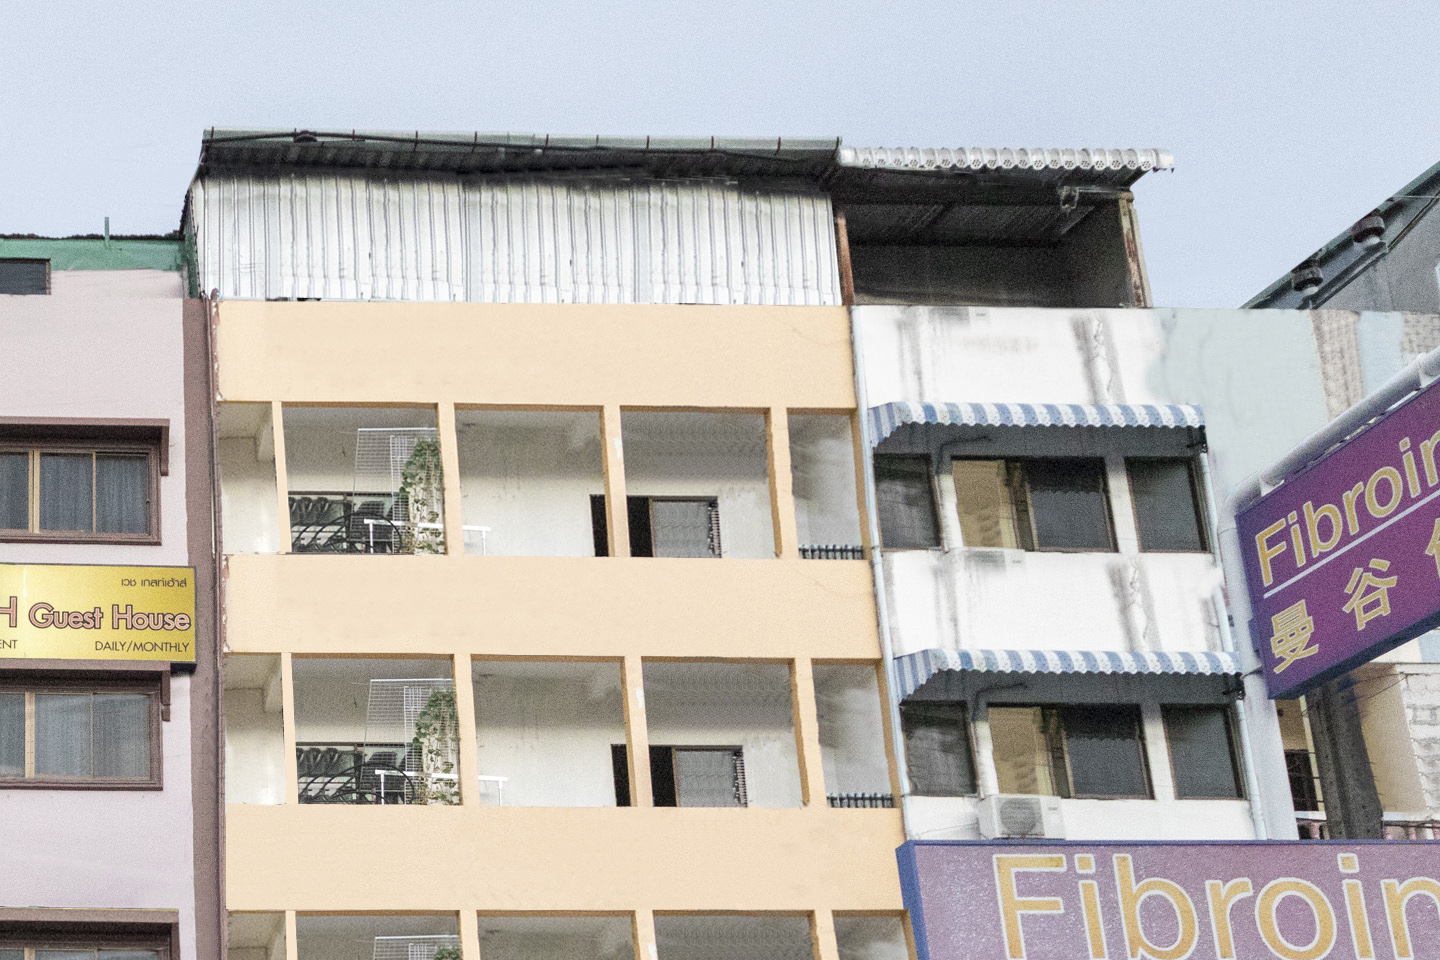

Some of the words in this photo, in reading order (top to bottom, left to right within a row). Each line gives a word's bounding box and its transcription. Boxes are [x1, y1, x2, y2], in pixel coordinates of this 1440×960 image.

[1270, 519, 1440, 675] 曼谷
[28, 602, 104, 630] Guest
[111, 604, 192, 631] House
[95, 641, 190, 653] DAILY/MONTHLY
